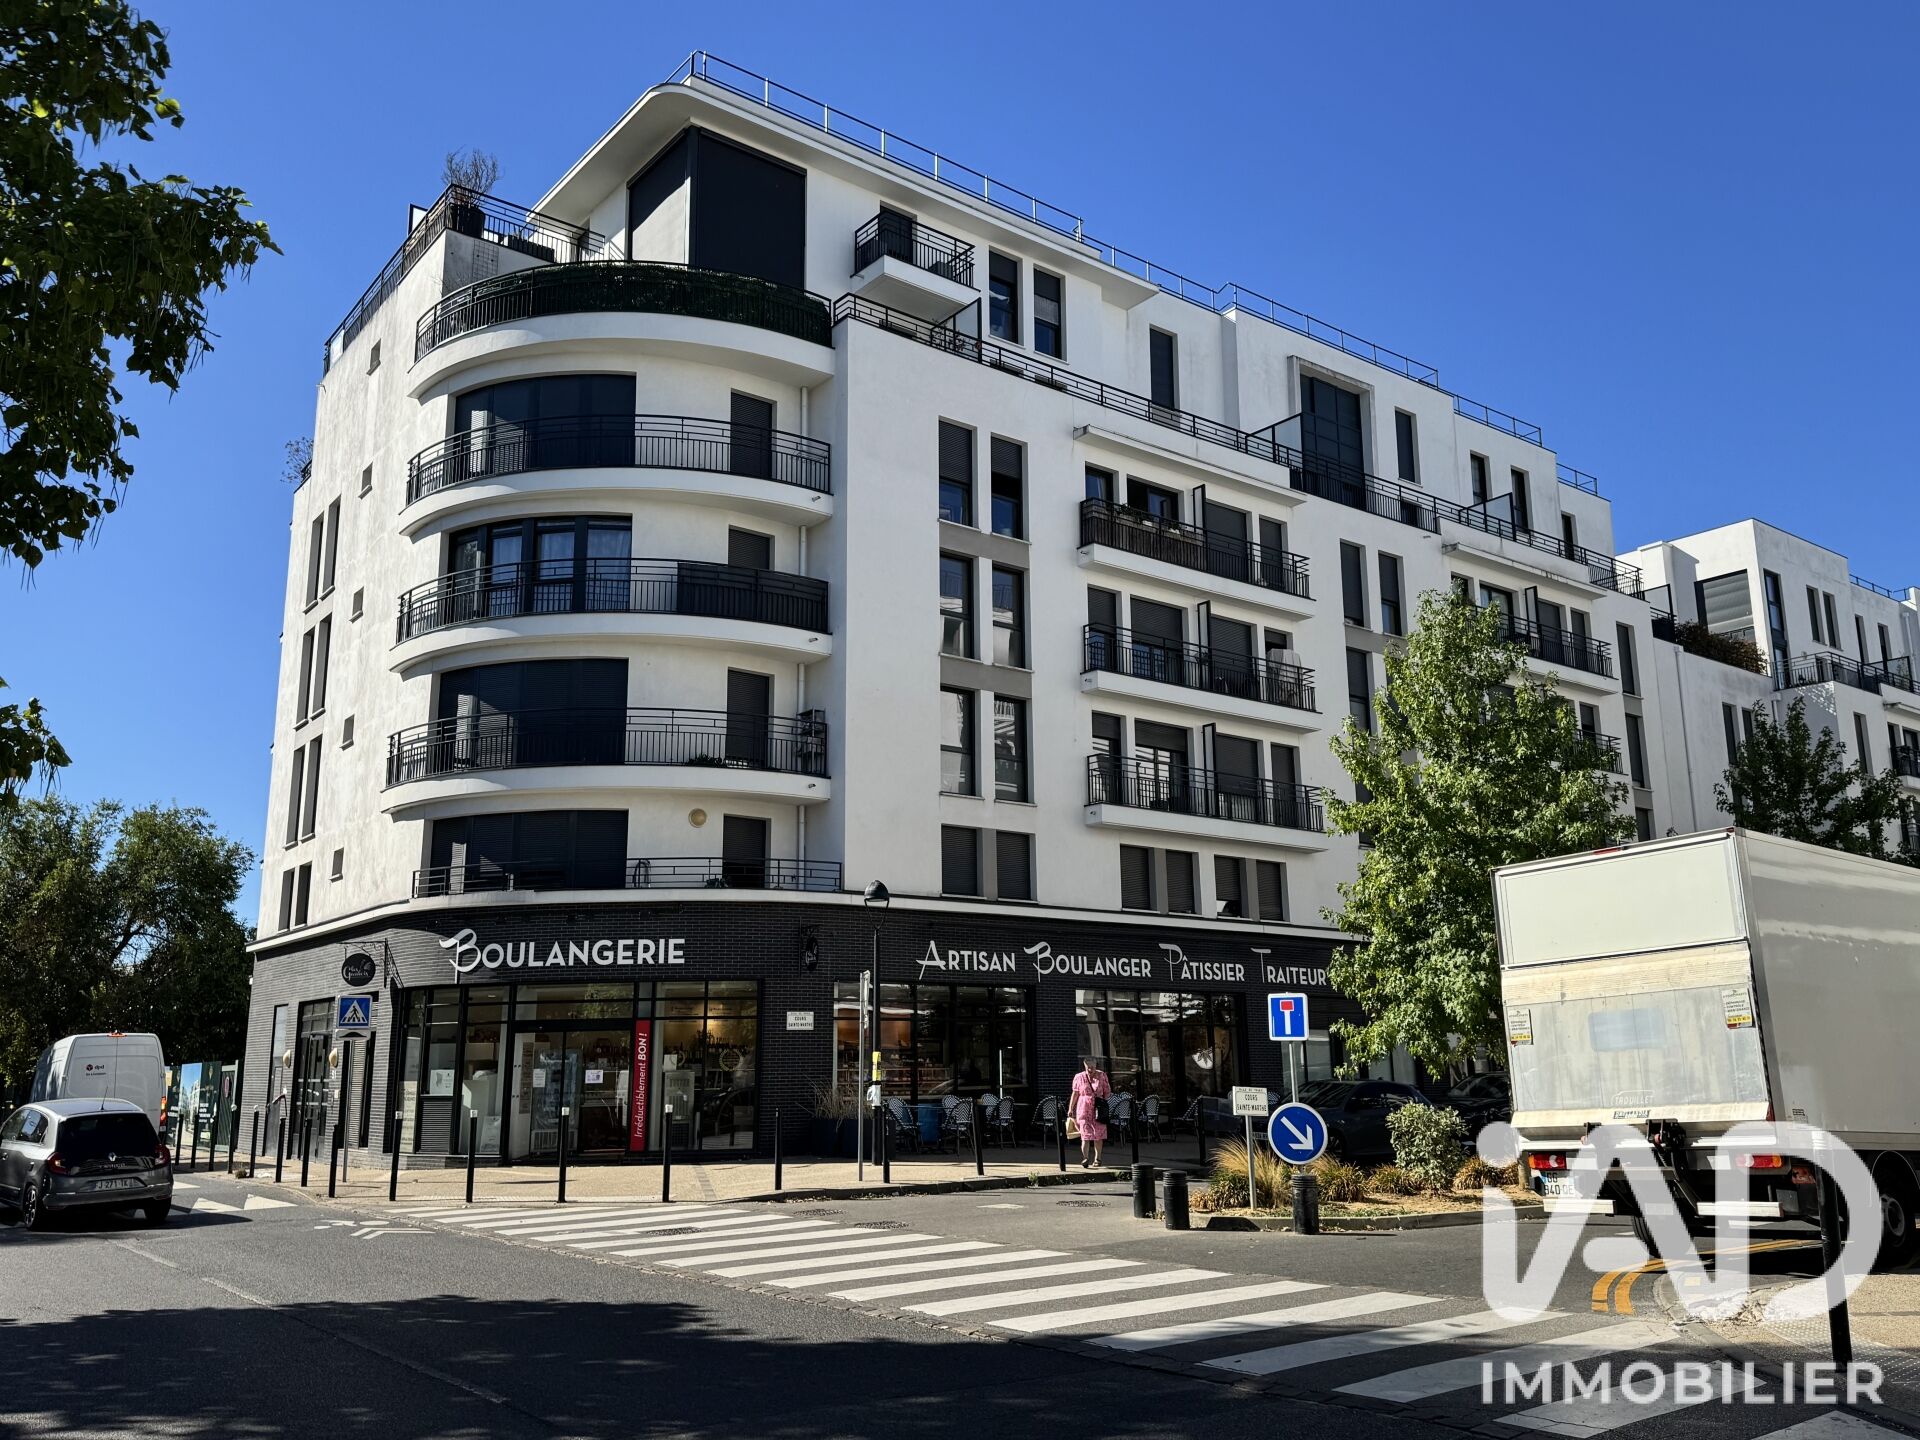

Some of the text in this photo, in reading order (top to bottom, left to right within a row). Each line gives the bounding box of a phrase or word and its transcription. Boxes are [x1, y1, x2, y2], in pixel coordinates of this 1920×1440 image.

[439, 929, 685, 984] BOULANGERIE
[916, 940, 1327, 986] ARTISAN BOULANGER PÂTISSIER TRAITEUR
[638, 1038, 646, 1061] BON
[634, 1062, 646, 1138] Irréductiblement
[1236, 1103, 1267, 1112] SAINTE-MARTHE
